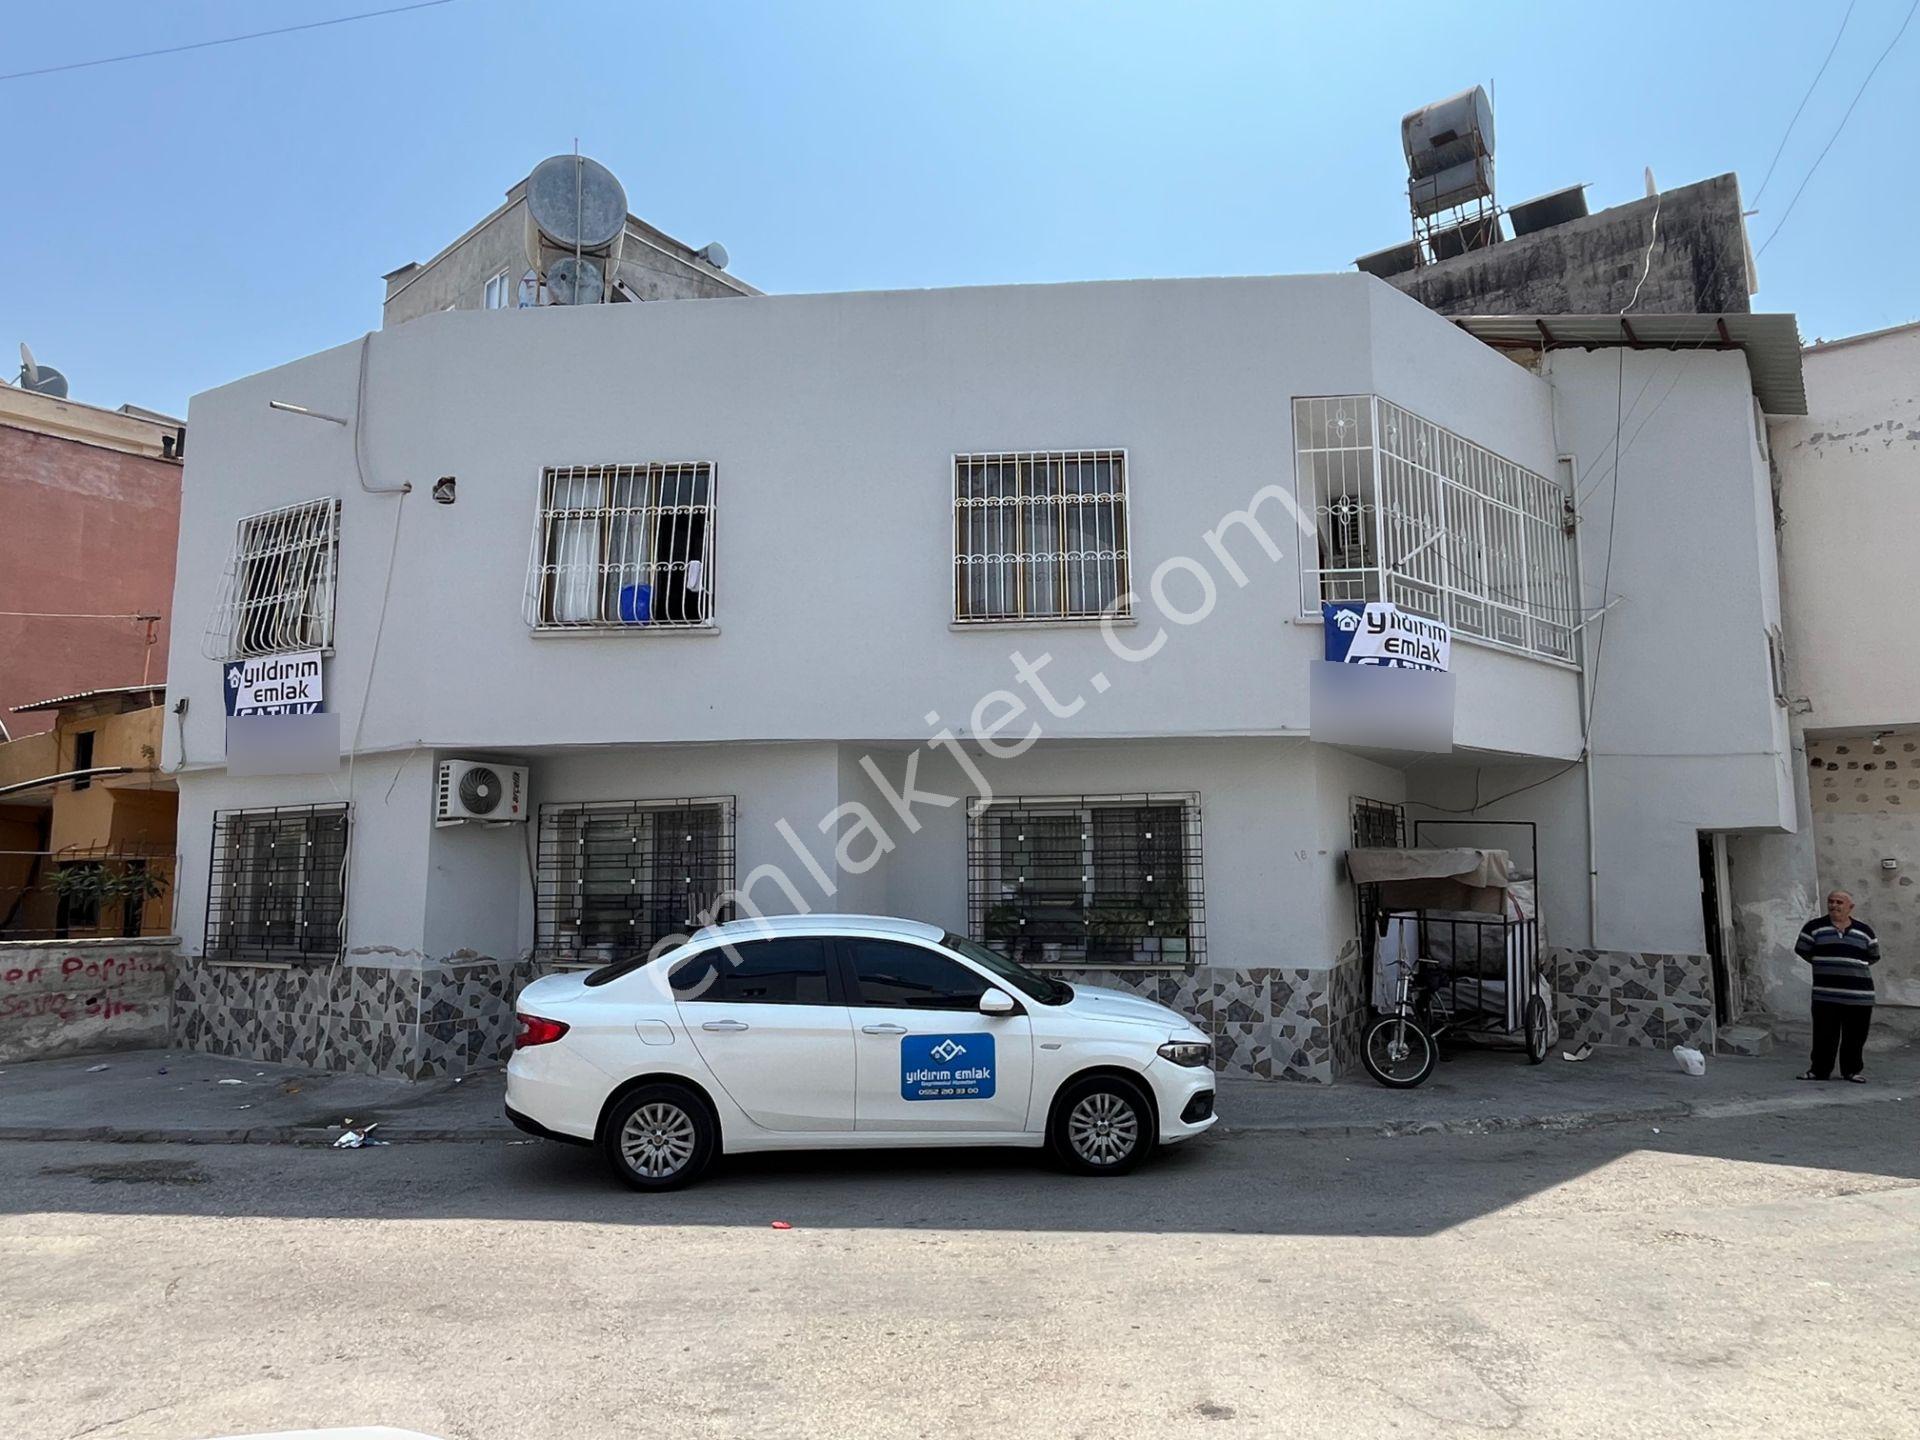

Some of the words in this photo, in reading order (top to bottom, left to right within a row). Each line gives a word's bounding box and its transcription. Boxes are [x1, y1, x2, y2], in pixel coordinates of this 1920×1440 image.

[1384, 637, 1441, 664] emlak
[244, 660, 319, 688] yıldırım
[254, 680, 310, 703] emlak
[906, 1069, 951, 1084] yıldırım
